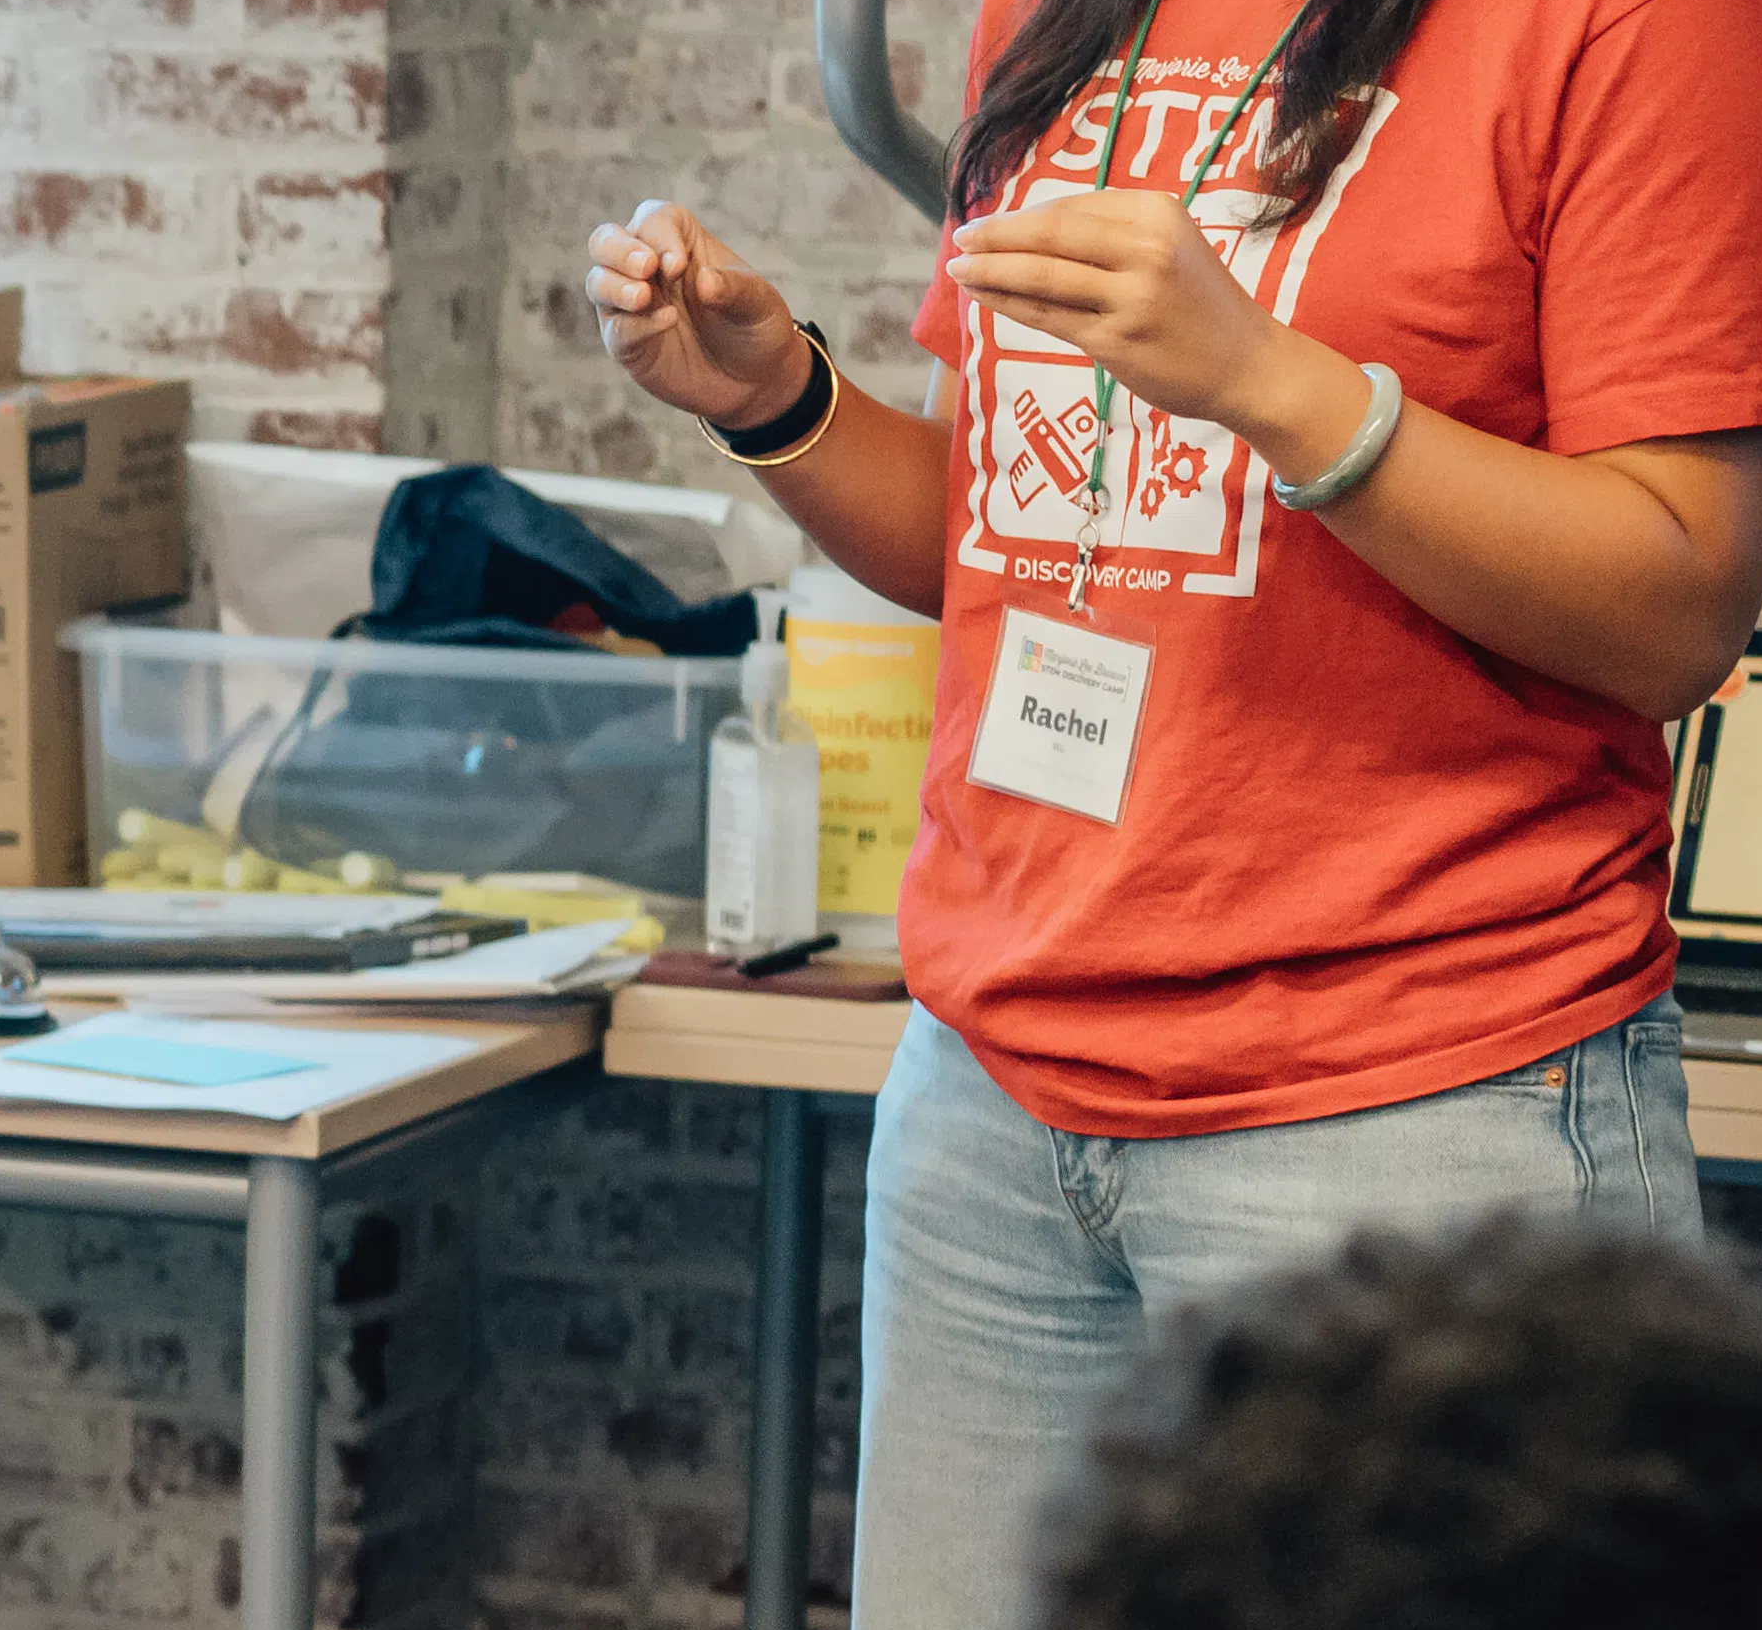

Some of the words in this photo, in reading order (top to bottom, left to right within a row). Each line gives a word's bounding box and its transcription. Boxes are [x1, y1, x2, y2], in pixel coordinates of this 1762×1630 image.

[1133, 57, 1212, 85] Marjorie
[1211, 55, 1250, 88] Lee
[1125, 567, 1171, 591] CAMP
[1020, 695, 1108, 745] Rachel
